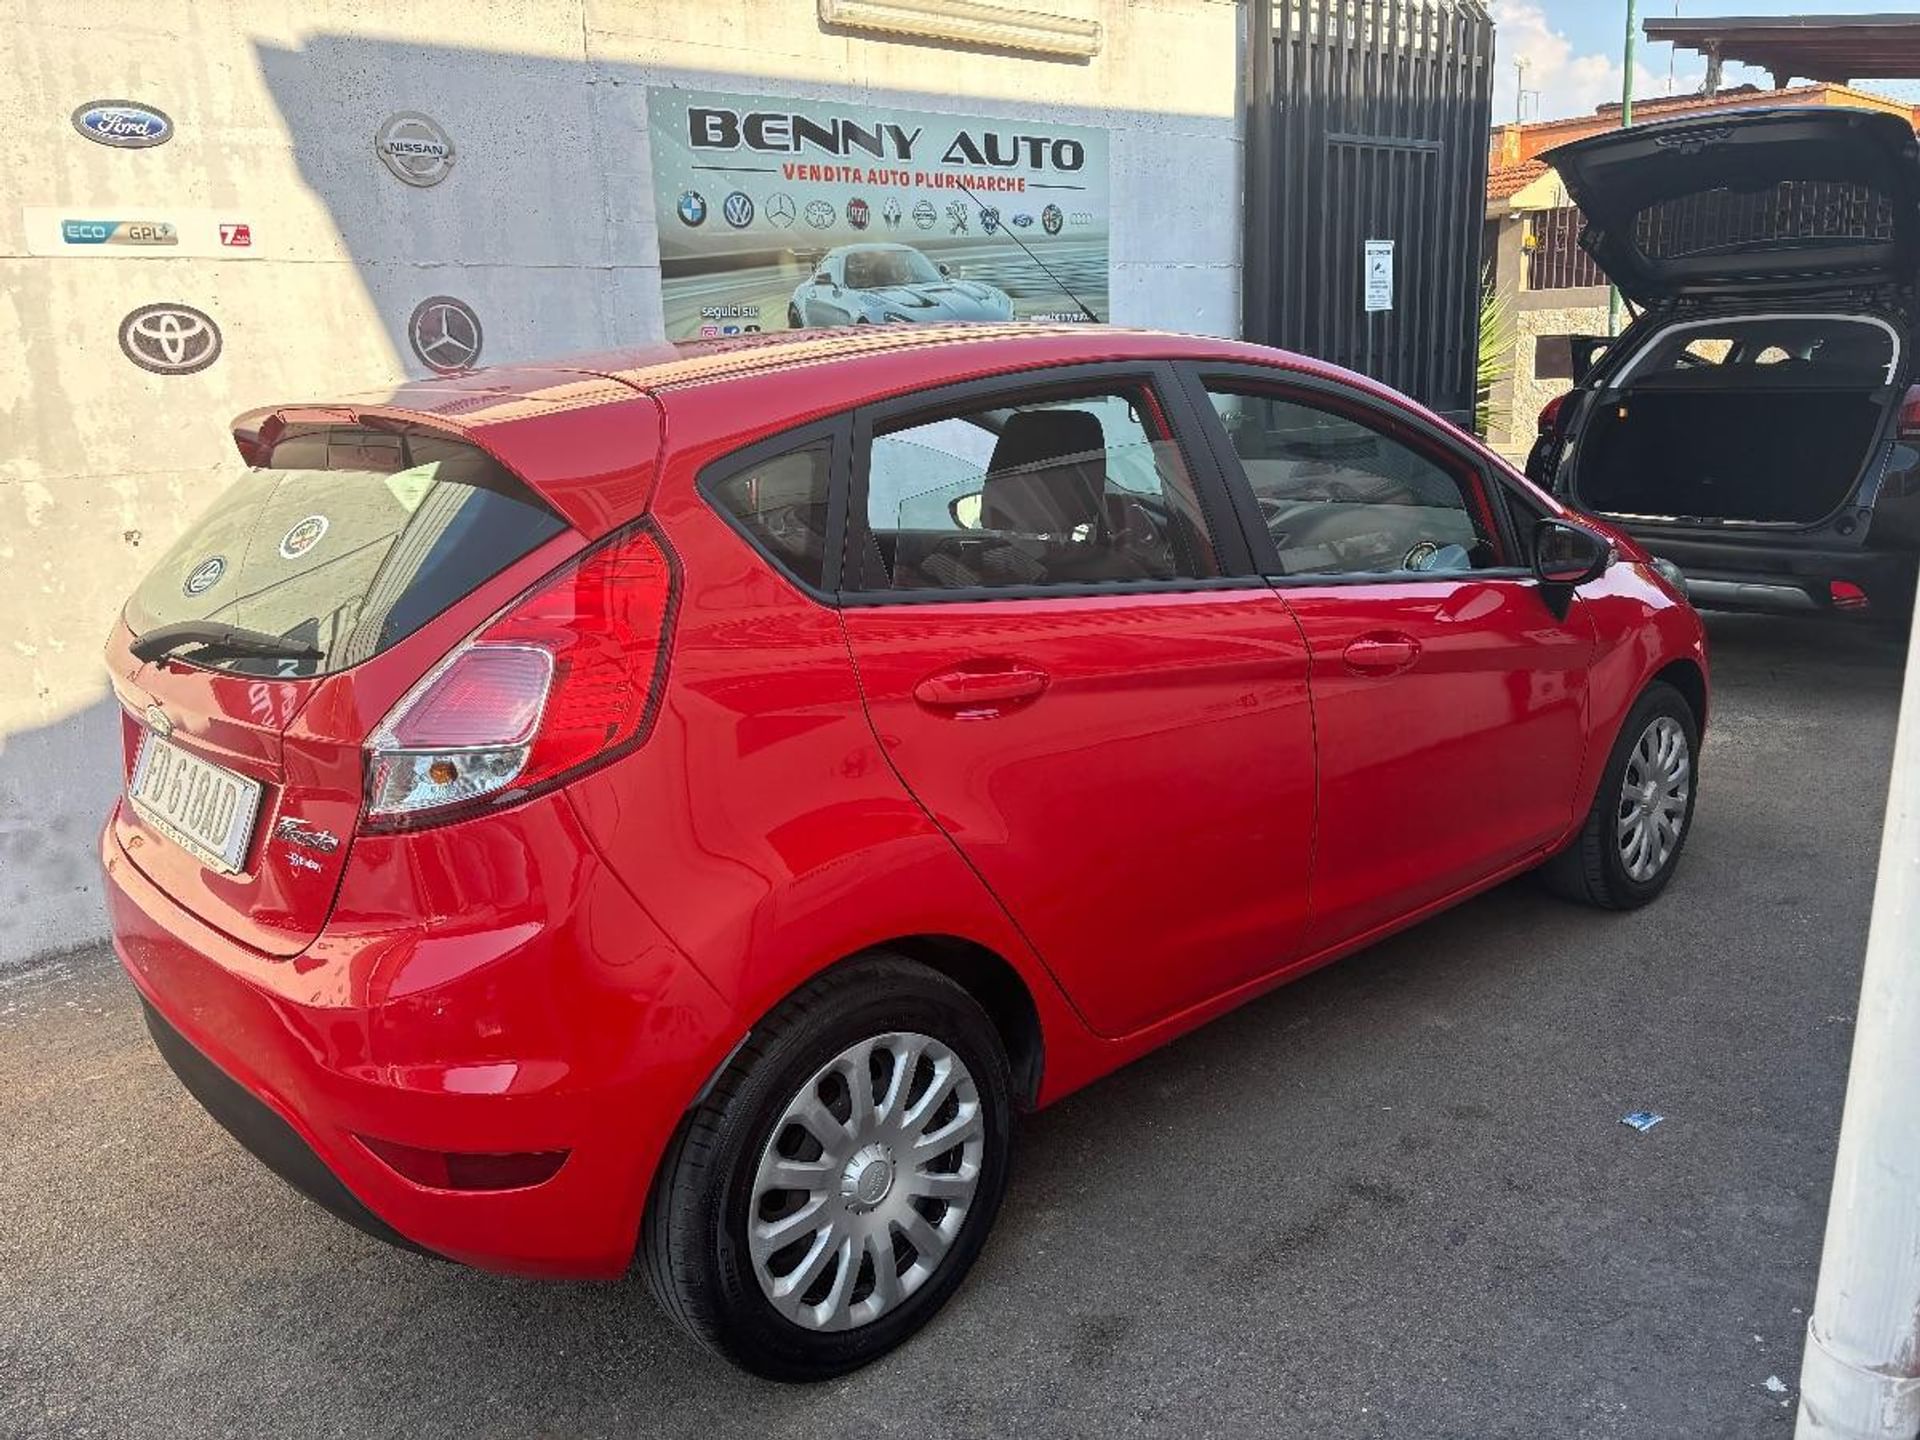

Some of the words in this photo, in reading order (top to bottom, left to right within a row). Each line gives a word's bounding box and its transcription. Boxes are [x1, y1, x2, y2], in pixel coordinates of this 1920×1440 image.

[98, 111, 150, 136] Ford
[389, 142, 443, 155] NISSAN
[688, 108, 922, 161] BENNY
[941, 131, 1085, 171] AUTO
[782, 163, 862, 184] VENDITA
[867, 168, 910, 188] AUTO
[915, 171, 1025, 193] PLURIMARCHE
[67, 225, 106, 239] ECO
[742, 305, 758, 317] su:
